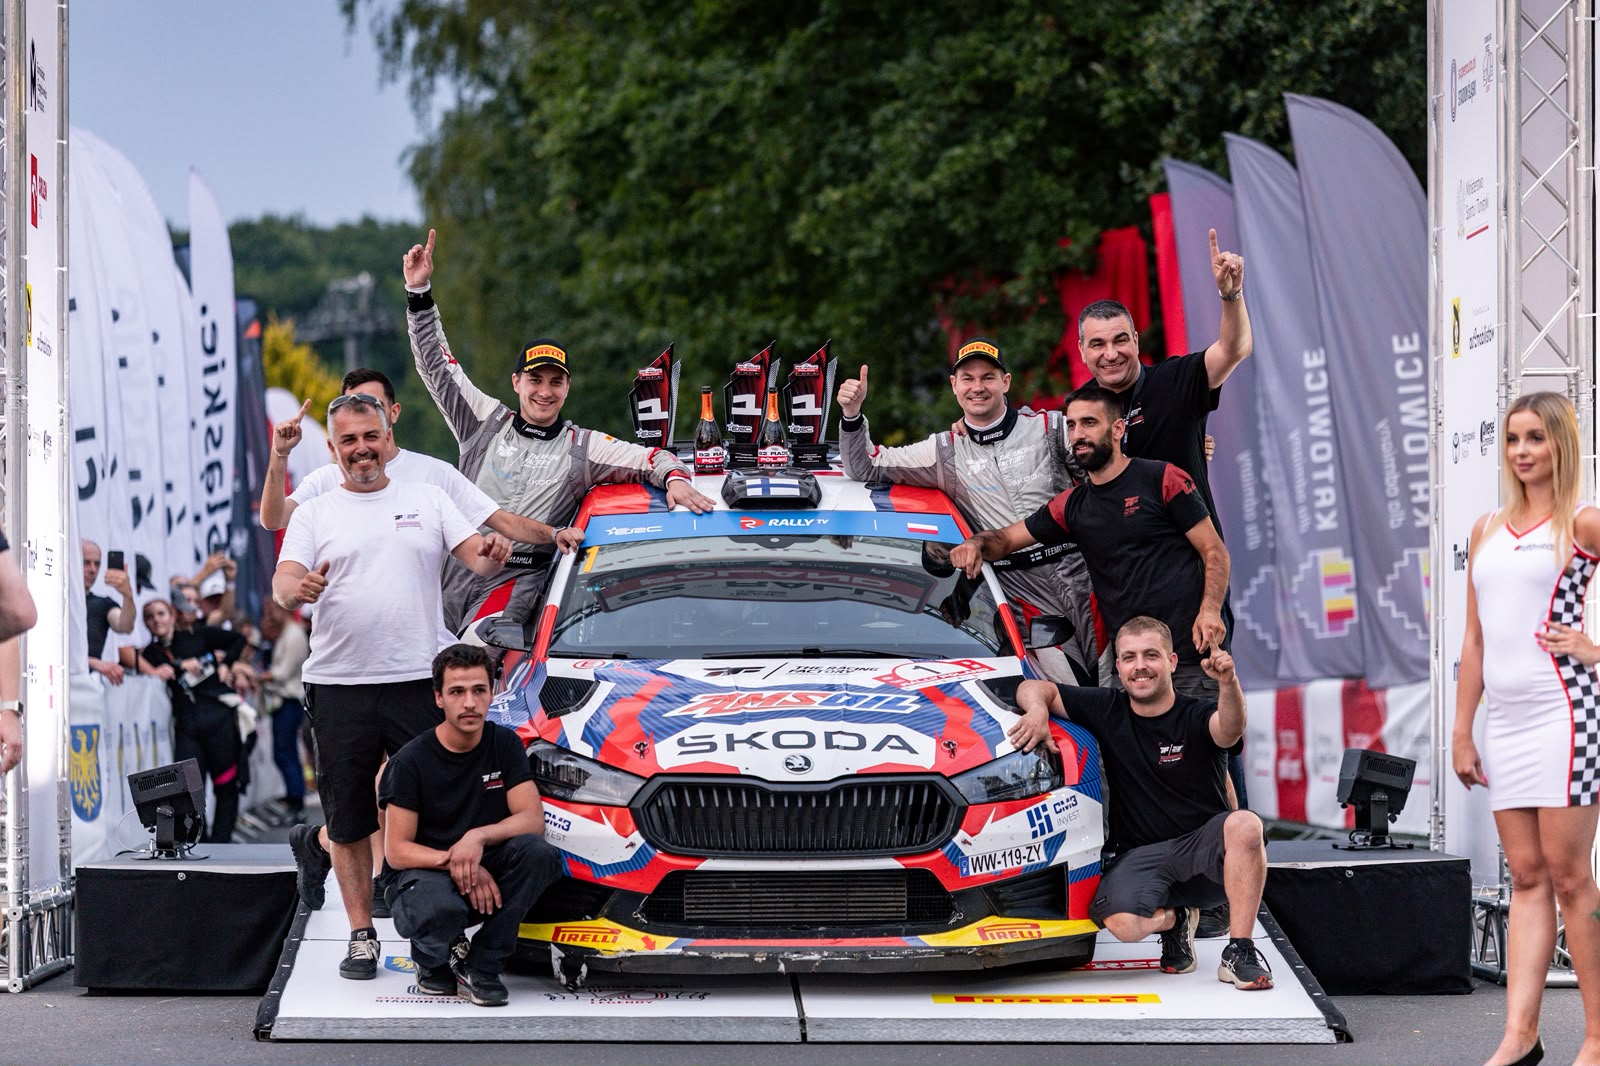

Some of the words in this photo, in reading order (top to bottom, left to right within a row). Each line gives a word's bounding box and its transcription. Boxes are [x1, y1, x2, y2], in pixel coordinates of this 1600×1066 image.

[638, 398, 668, 421] 1
[731, 394, 762, 416] 1
[792, 394, 822, 415] 1
[768, 518, 813, 526] RALLY
[583, 546, 600, 573] 1
[912, 665, 941, 674] 1
[677, 691, 919, 716] AMSOIL
[1053, 795, 1078, 814] CM3
[1056, 810, 1081, 826] INVEST
[971, 843, 1041, 873] WW-119-ZY
[552, 926, 621, 943] PIRELLI
[976, 923, 1042, 942] PIRELLI
